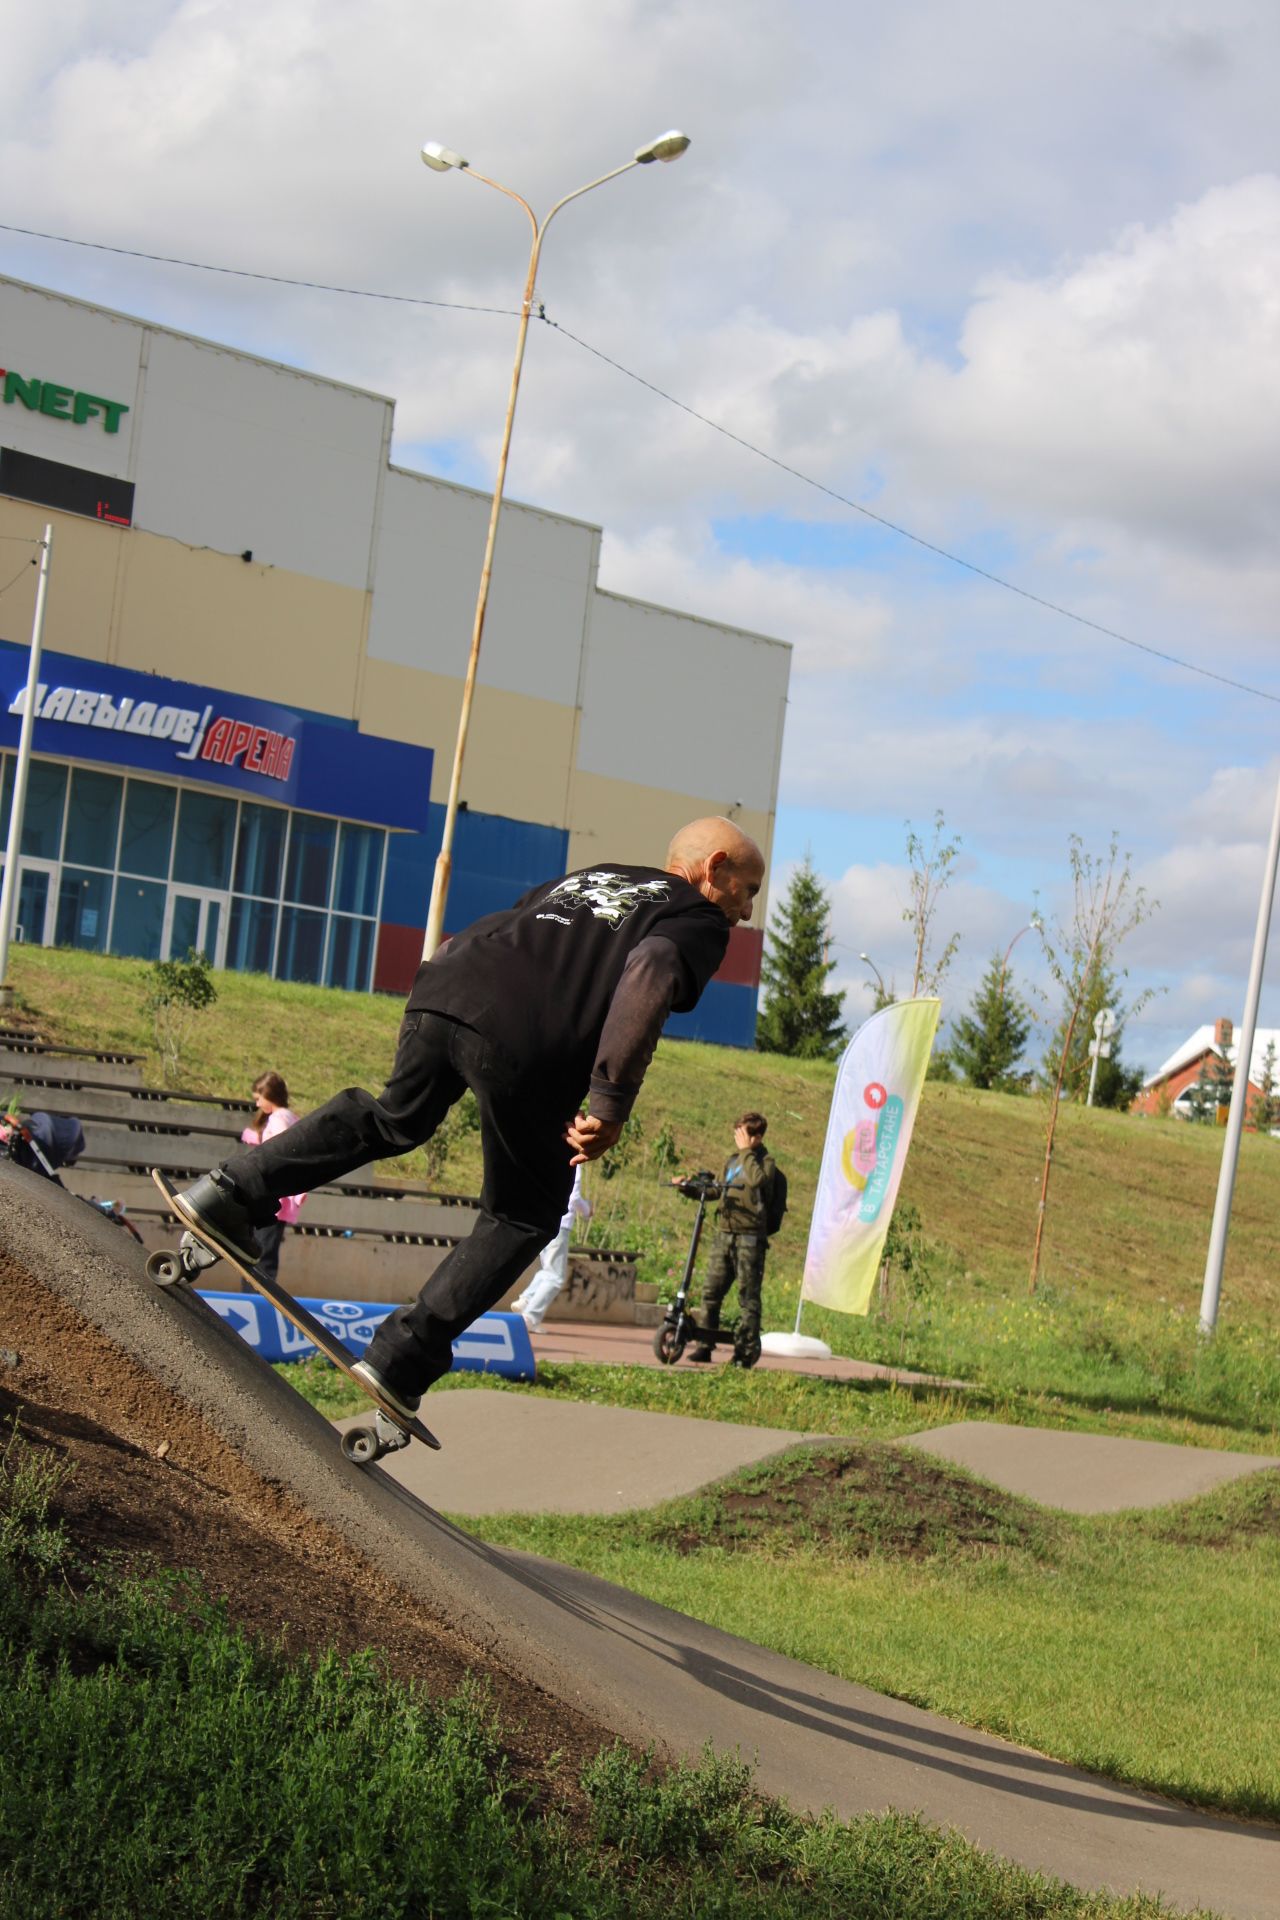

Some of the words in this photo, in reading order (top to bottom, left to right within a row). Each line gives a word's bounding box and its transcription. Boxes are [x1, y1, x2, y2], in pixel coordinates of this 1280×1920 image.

[0, 367, 130, 433] NEFT
[201, 716, 296, 782] АРЕНА
[868, 1103, 899, 1196] ТАТАРСТАНЕ
